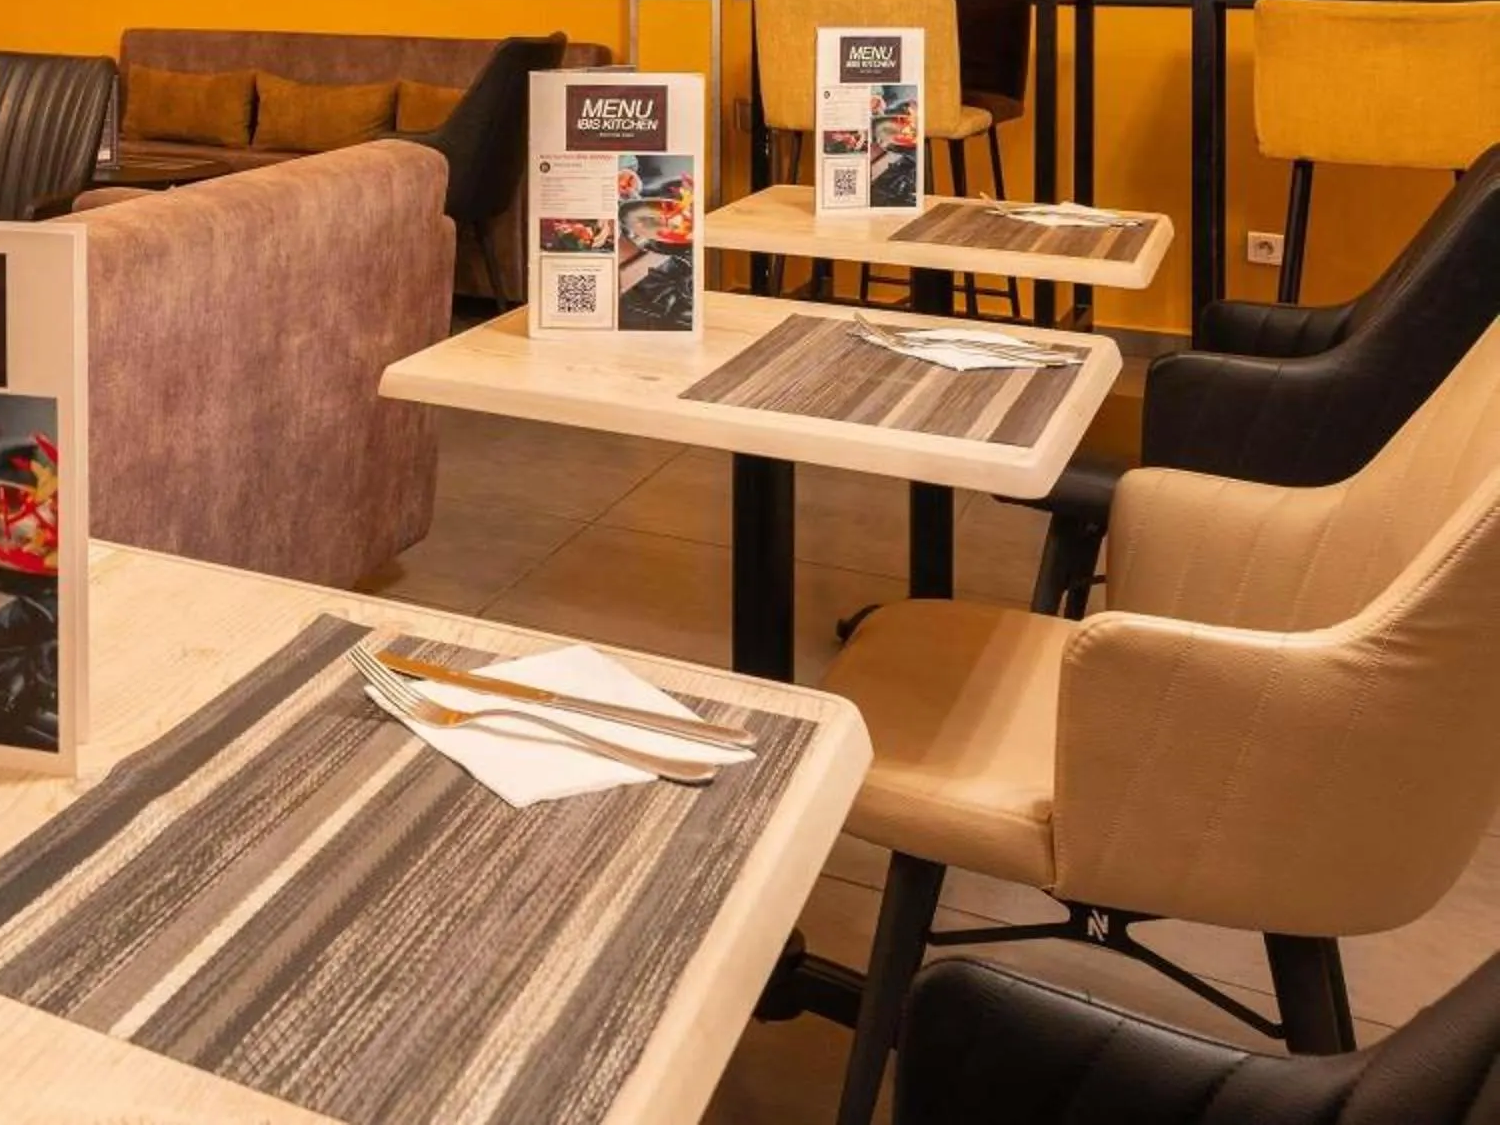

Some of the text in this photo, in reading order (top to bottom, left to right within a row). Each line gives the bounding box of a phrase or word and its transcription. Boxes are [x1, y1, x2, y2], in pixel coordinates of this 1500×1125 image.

[849, 45, 893, 60] MENU
[582, 98, 654, 118] MENU
[577, 118, 658, 131] IBIS KITCHEN
